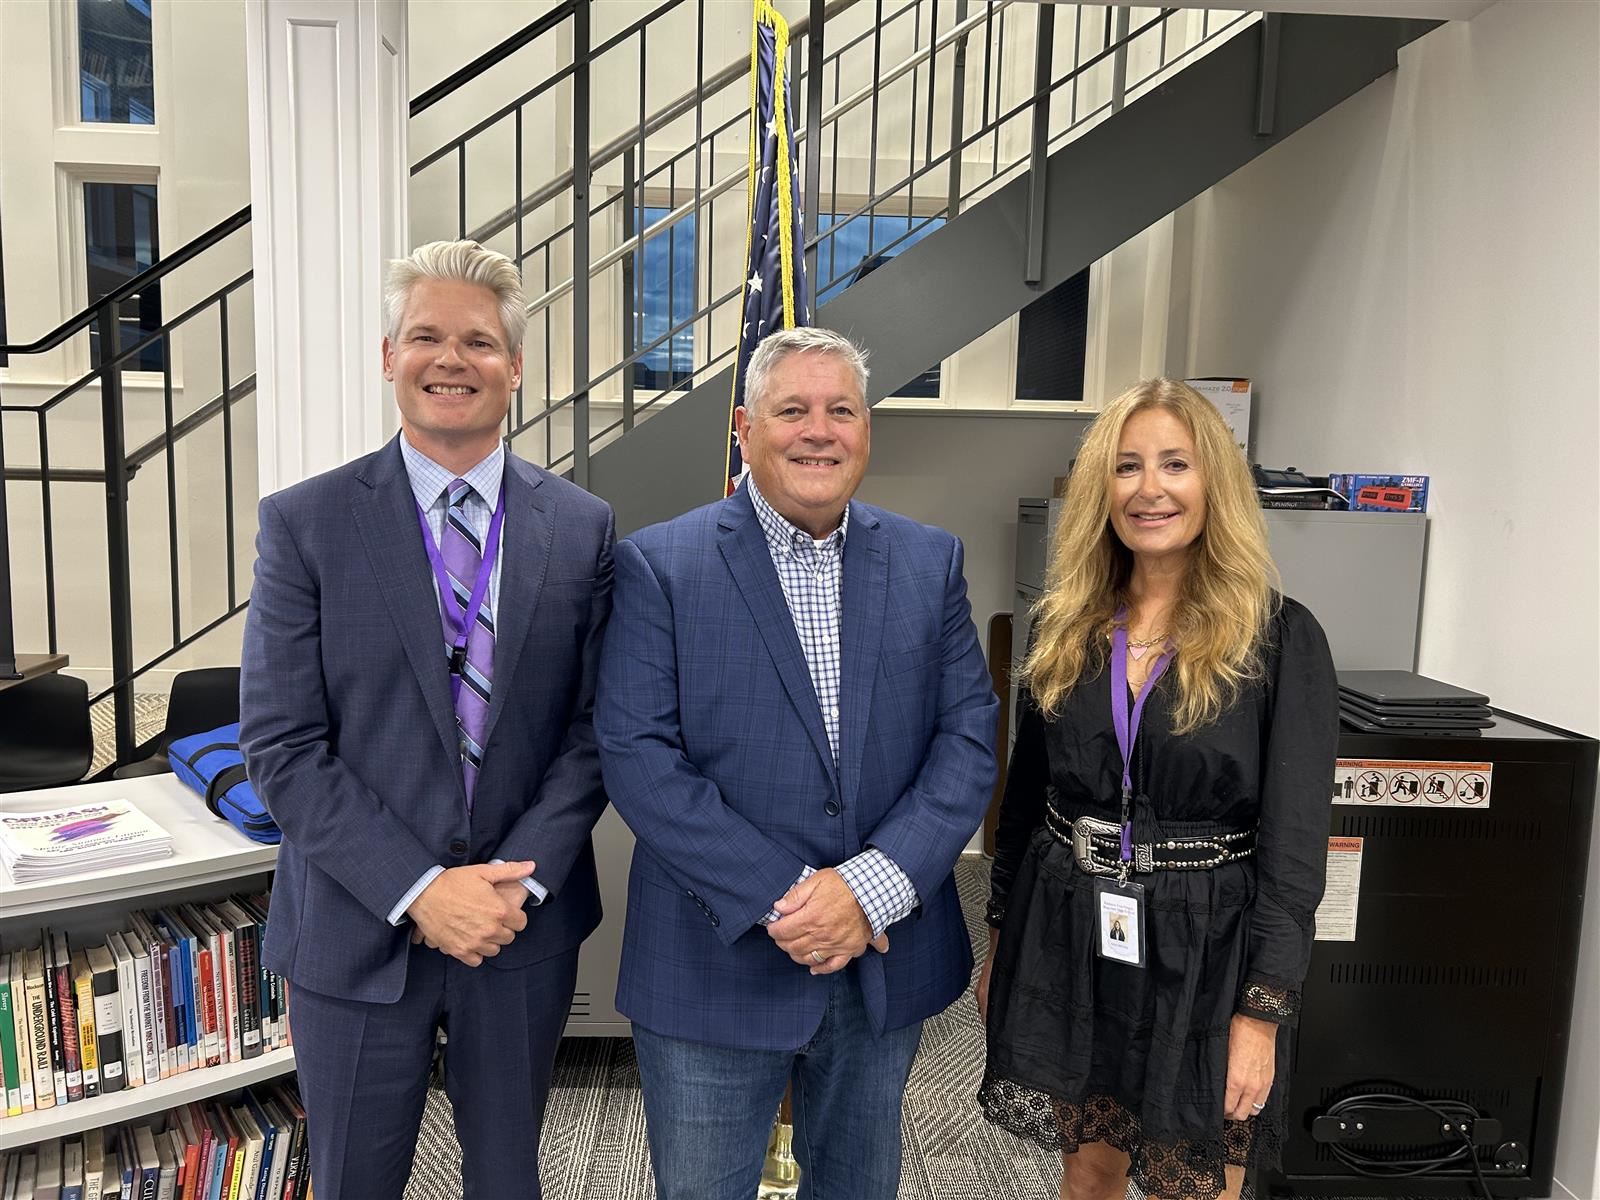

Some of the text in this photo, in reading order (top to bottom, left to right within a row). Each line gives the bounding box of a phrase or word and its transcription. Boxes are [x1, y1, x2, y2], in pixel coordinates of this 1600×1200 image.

[32, 1001, 46, 1050] UNDERGROUND
[288, 1156, 299, 1179] VIRAL
[88, 1178, 100, 1190] THE
